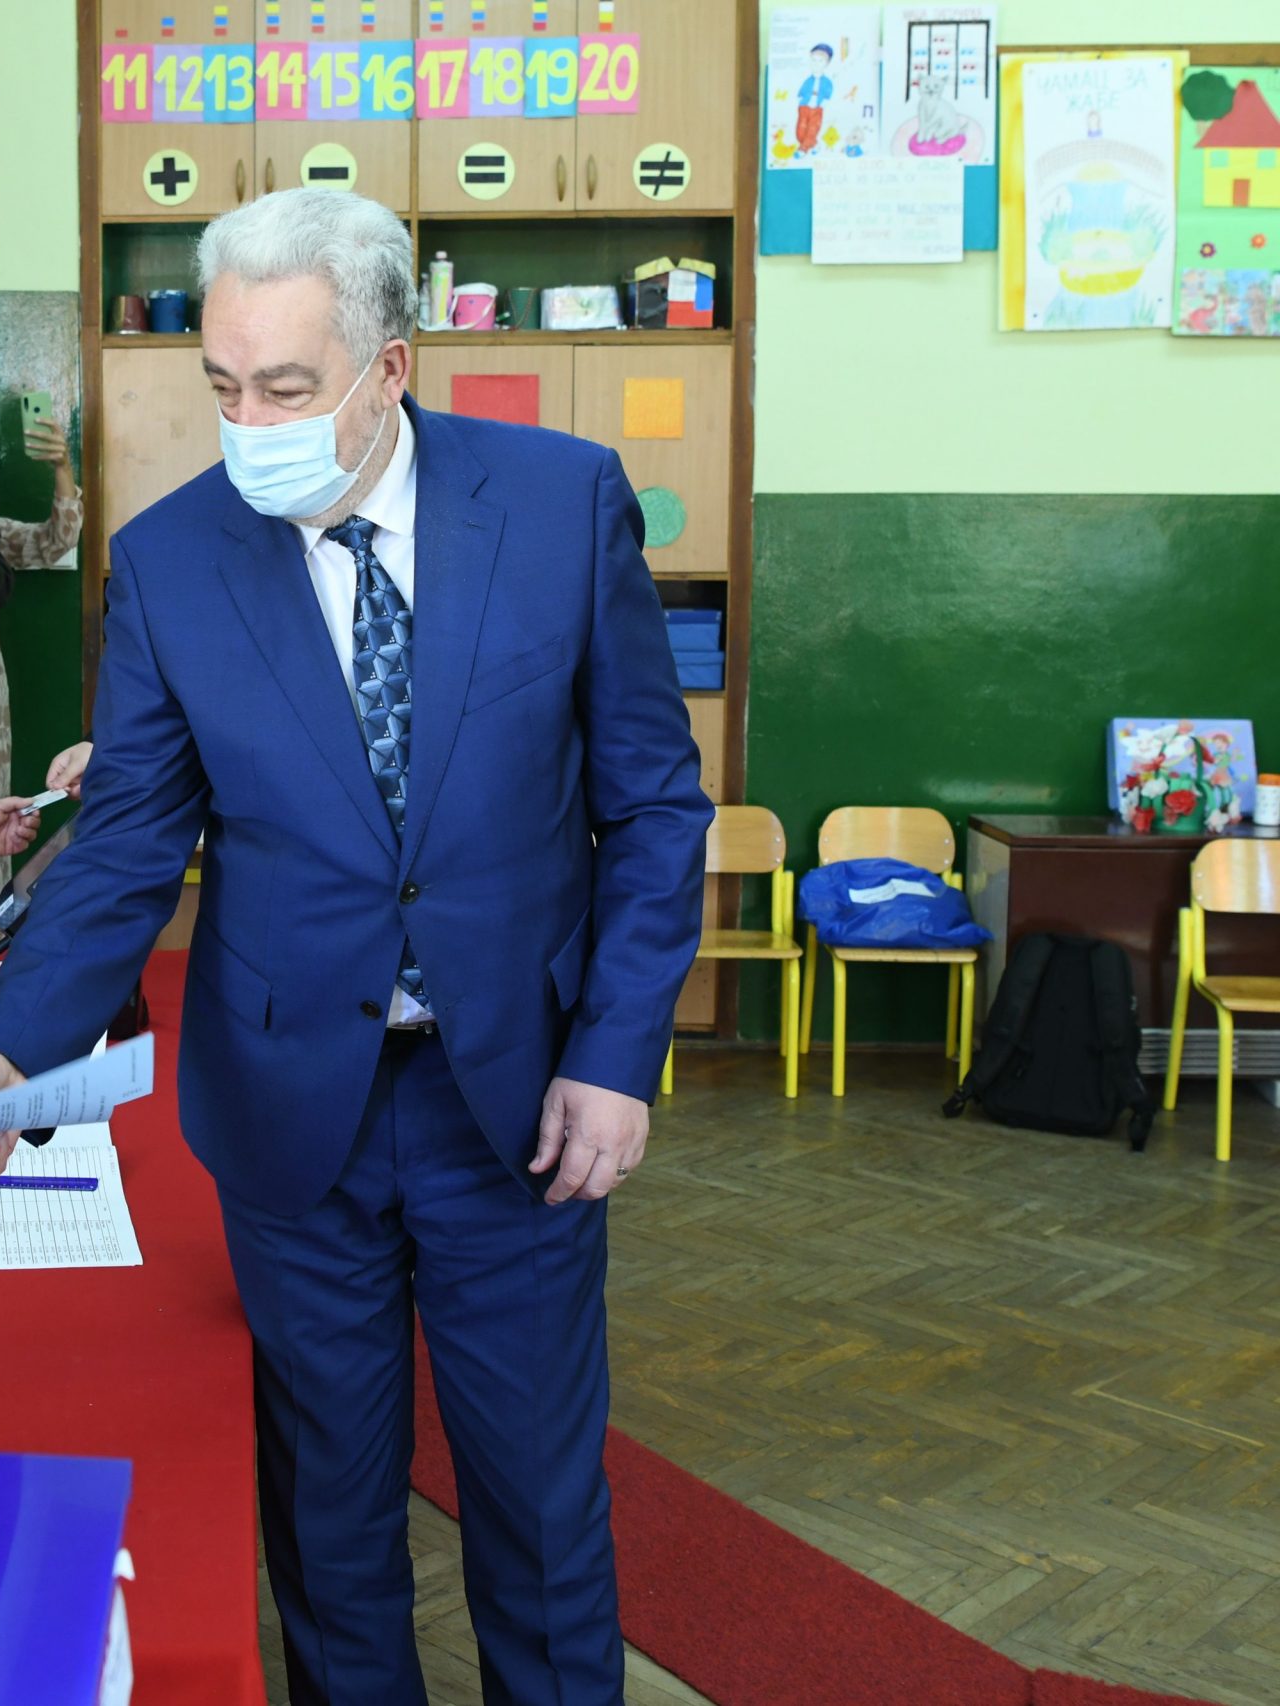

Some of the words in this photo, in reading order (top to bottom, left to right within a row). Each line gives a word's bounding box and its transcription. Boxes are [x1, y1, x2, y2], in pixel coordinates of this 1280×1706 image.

[101, 53, 147, 110] 11
[154, 55, 204, 112] 12
[204, 54, 255, 111] 13
[256, 51, 307, 109] 14
[309, 52, 360, 109] 15
[361, 54, 415, 112] 16
[416, 49, 468, 109] 17
[470, 47, 525, 105] 18
[525, 48, 578, 109] 19
[578, 42, 639, 102] 20
